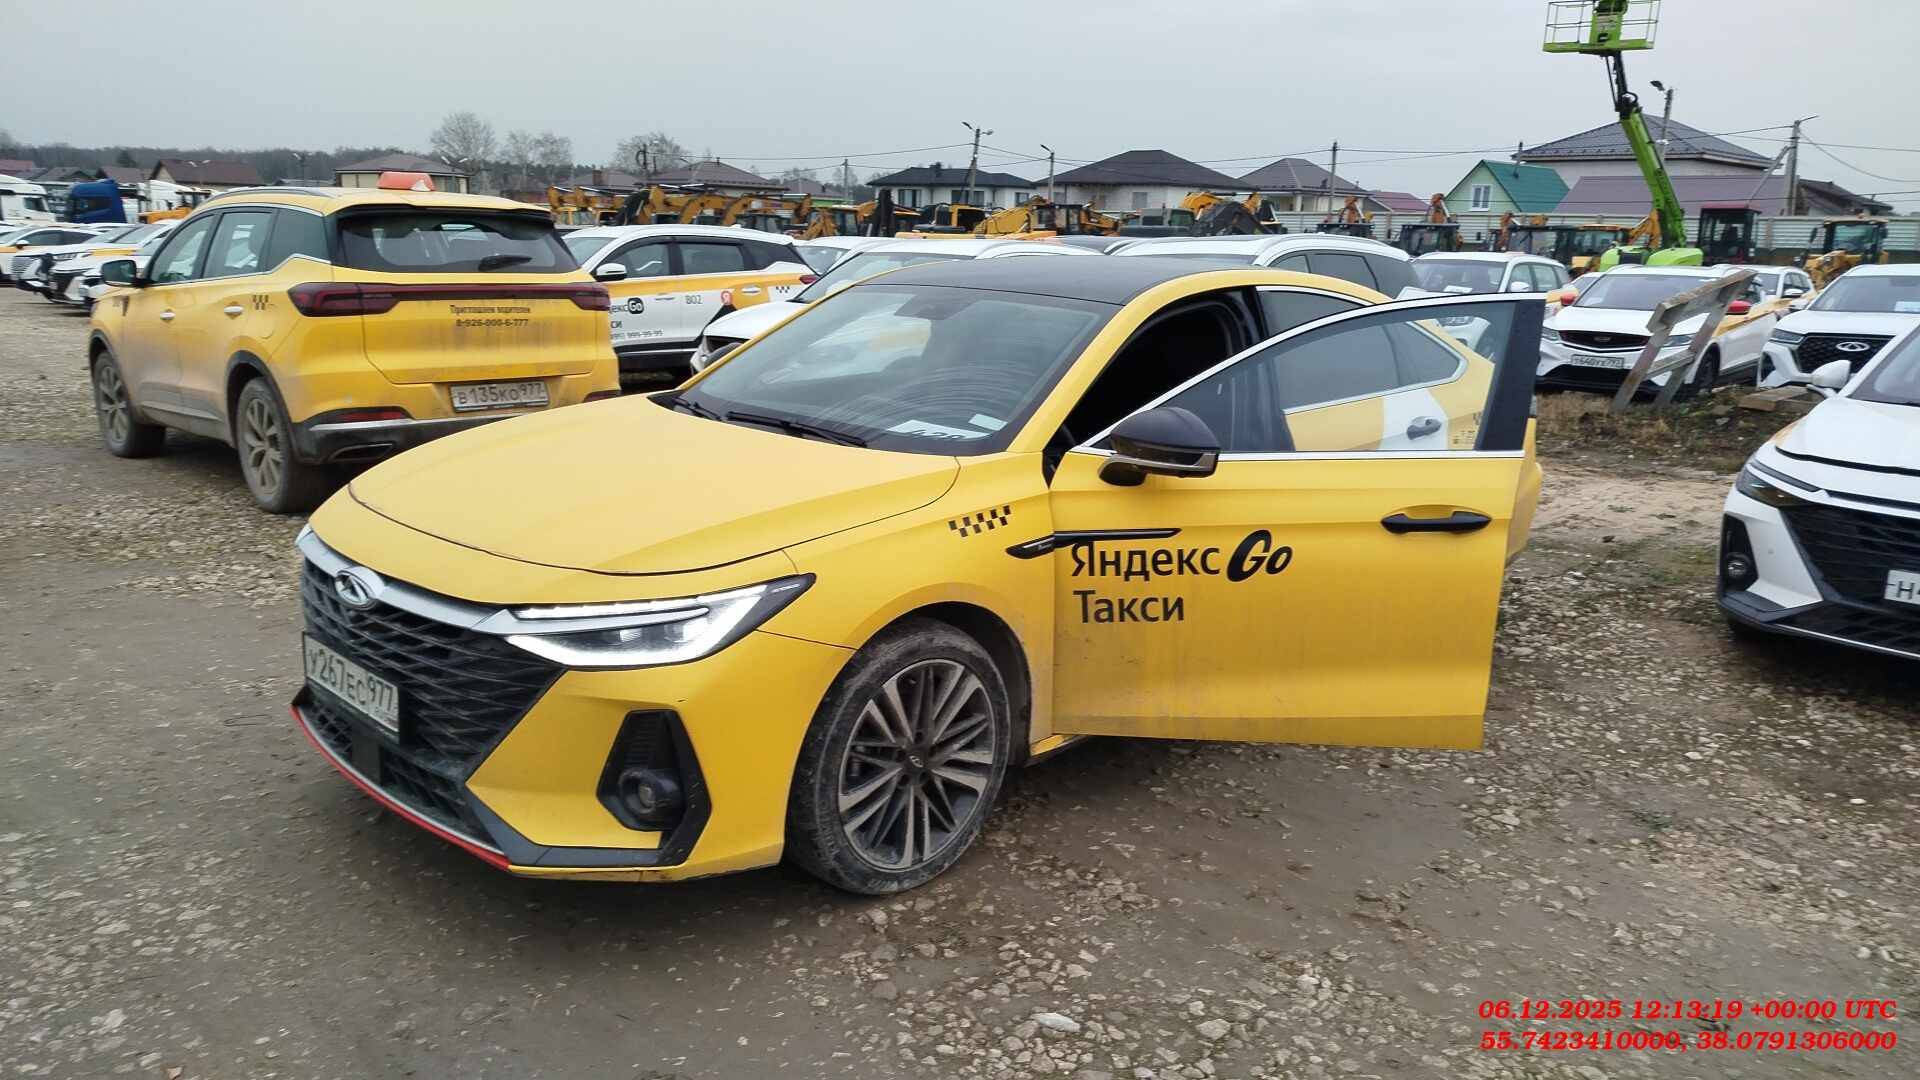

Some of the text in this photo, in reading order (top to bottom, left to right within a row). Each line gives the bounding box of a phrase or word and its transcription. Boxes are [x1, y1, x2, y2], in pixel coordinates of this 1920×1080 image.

[1071, 529, 1293, 582] Яндекс Go
[1072, 590, 1185, 623] Такси
